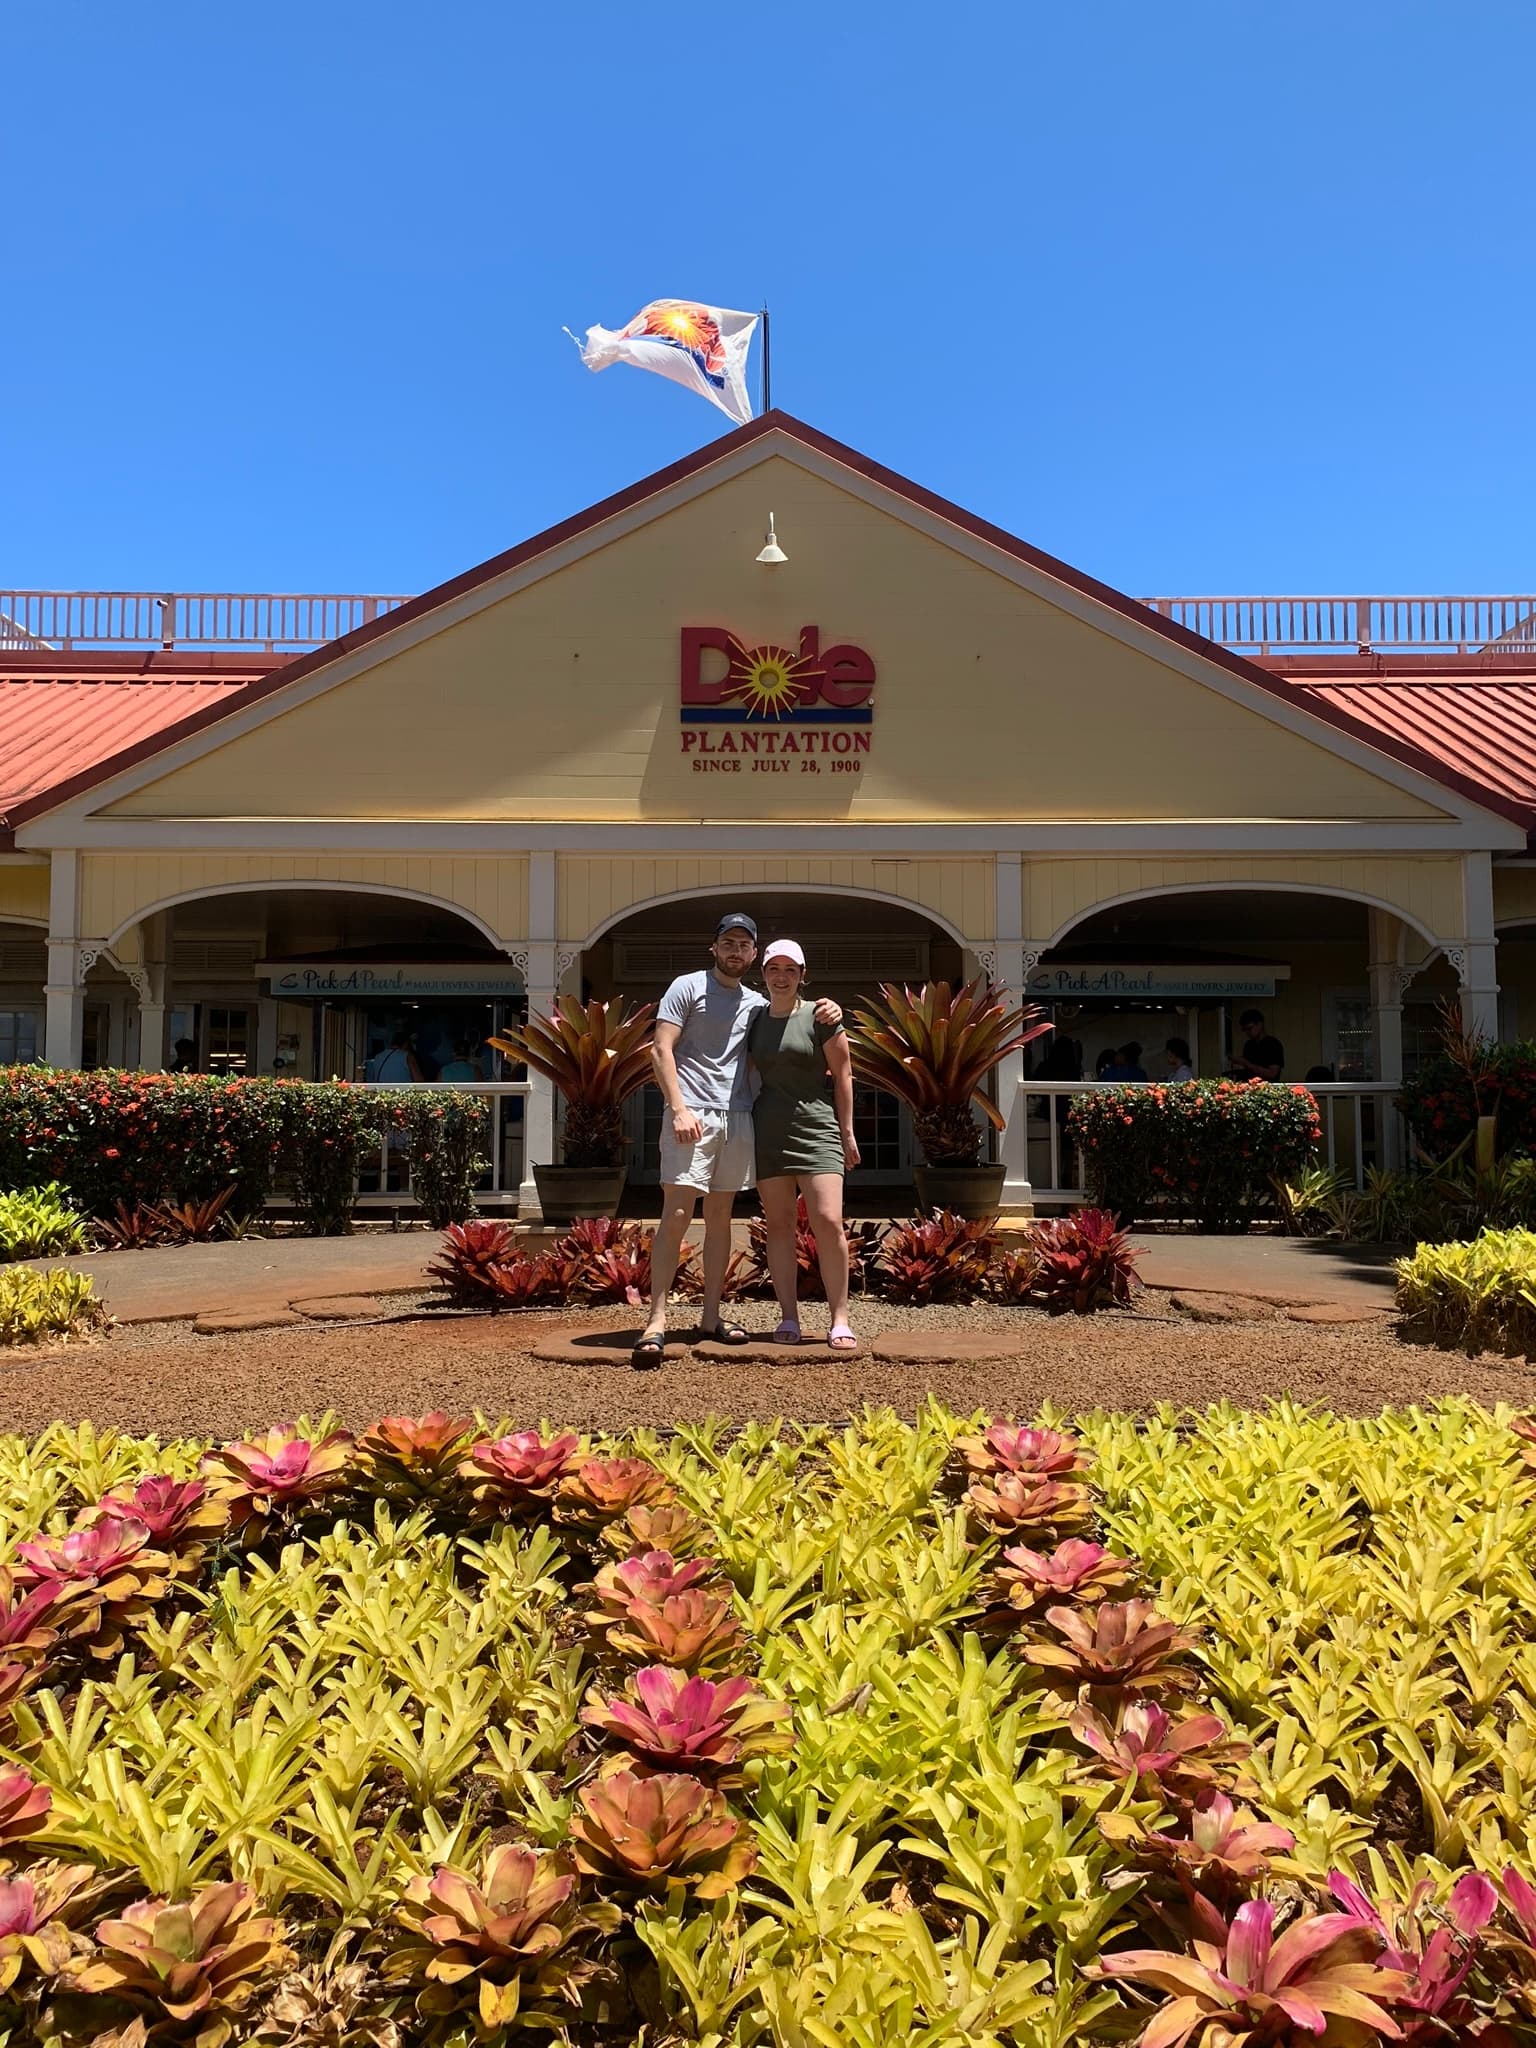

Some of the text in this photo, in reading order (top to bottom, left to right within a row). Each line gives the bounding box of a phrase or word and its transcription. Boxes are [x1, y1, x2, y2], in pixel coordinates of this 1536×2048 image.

[681, 626, 876, 712] Dole
[681, 731, 872, 753] PLANTATION
[693, 760, 860, 774] SINCE JULY 28, 1900
[303, 969, 404, 989] Pick A Pearl
[478, 981, 516, 990] JEWELRY
[1055, 970, 1153, 990] Pick A Pearl
[1191, 982, 1224, 991] DIVERS
[1226, 982, 1266, 991] JEWELRY
